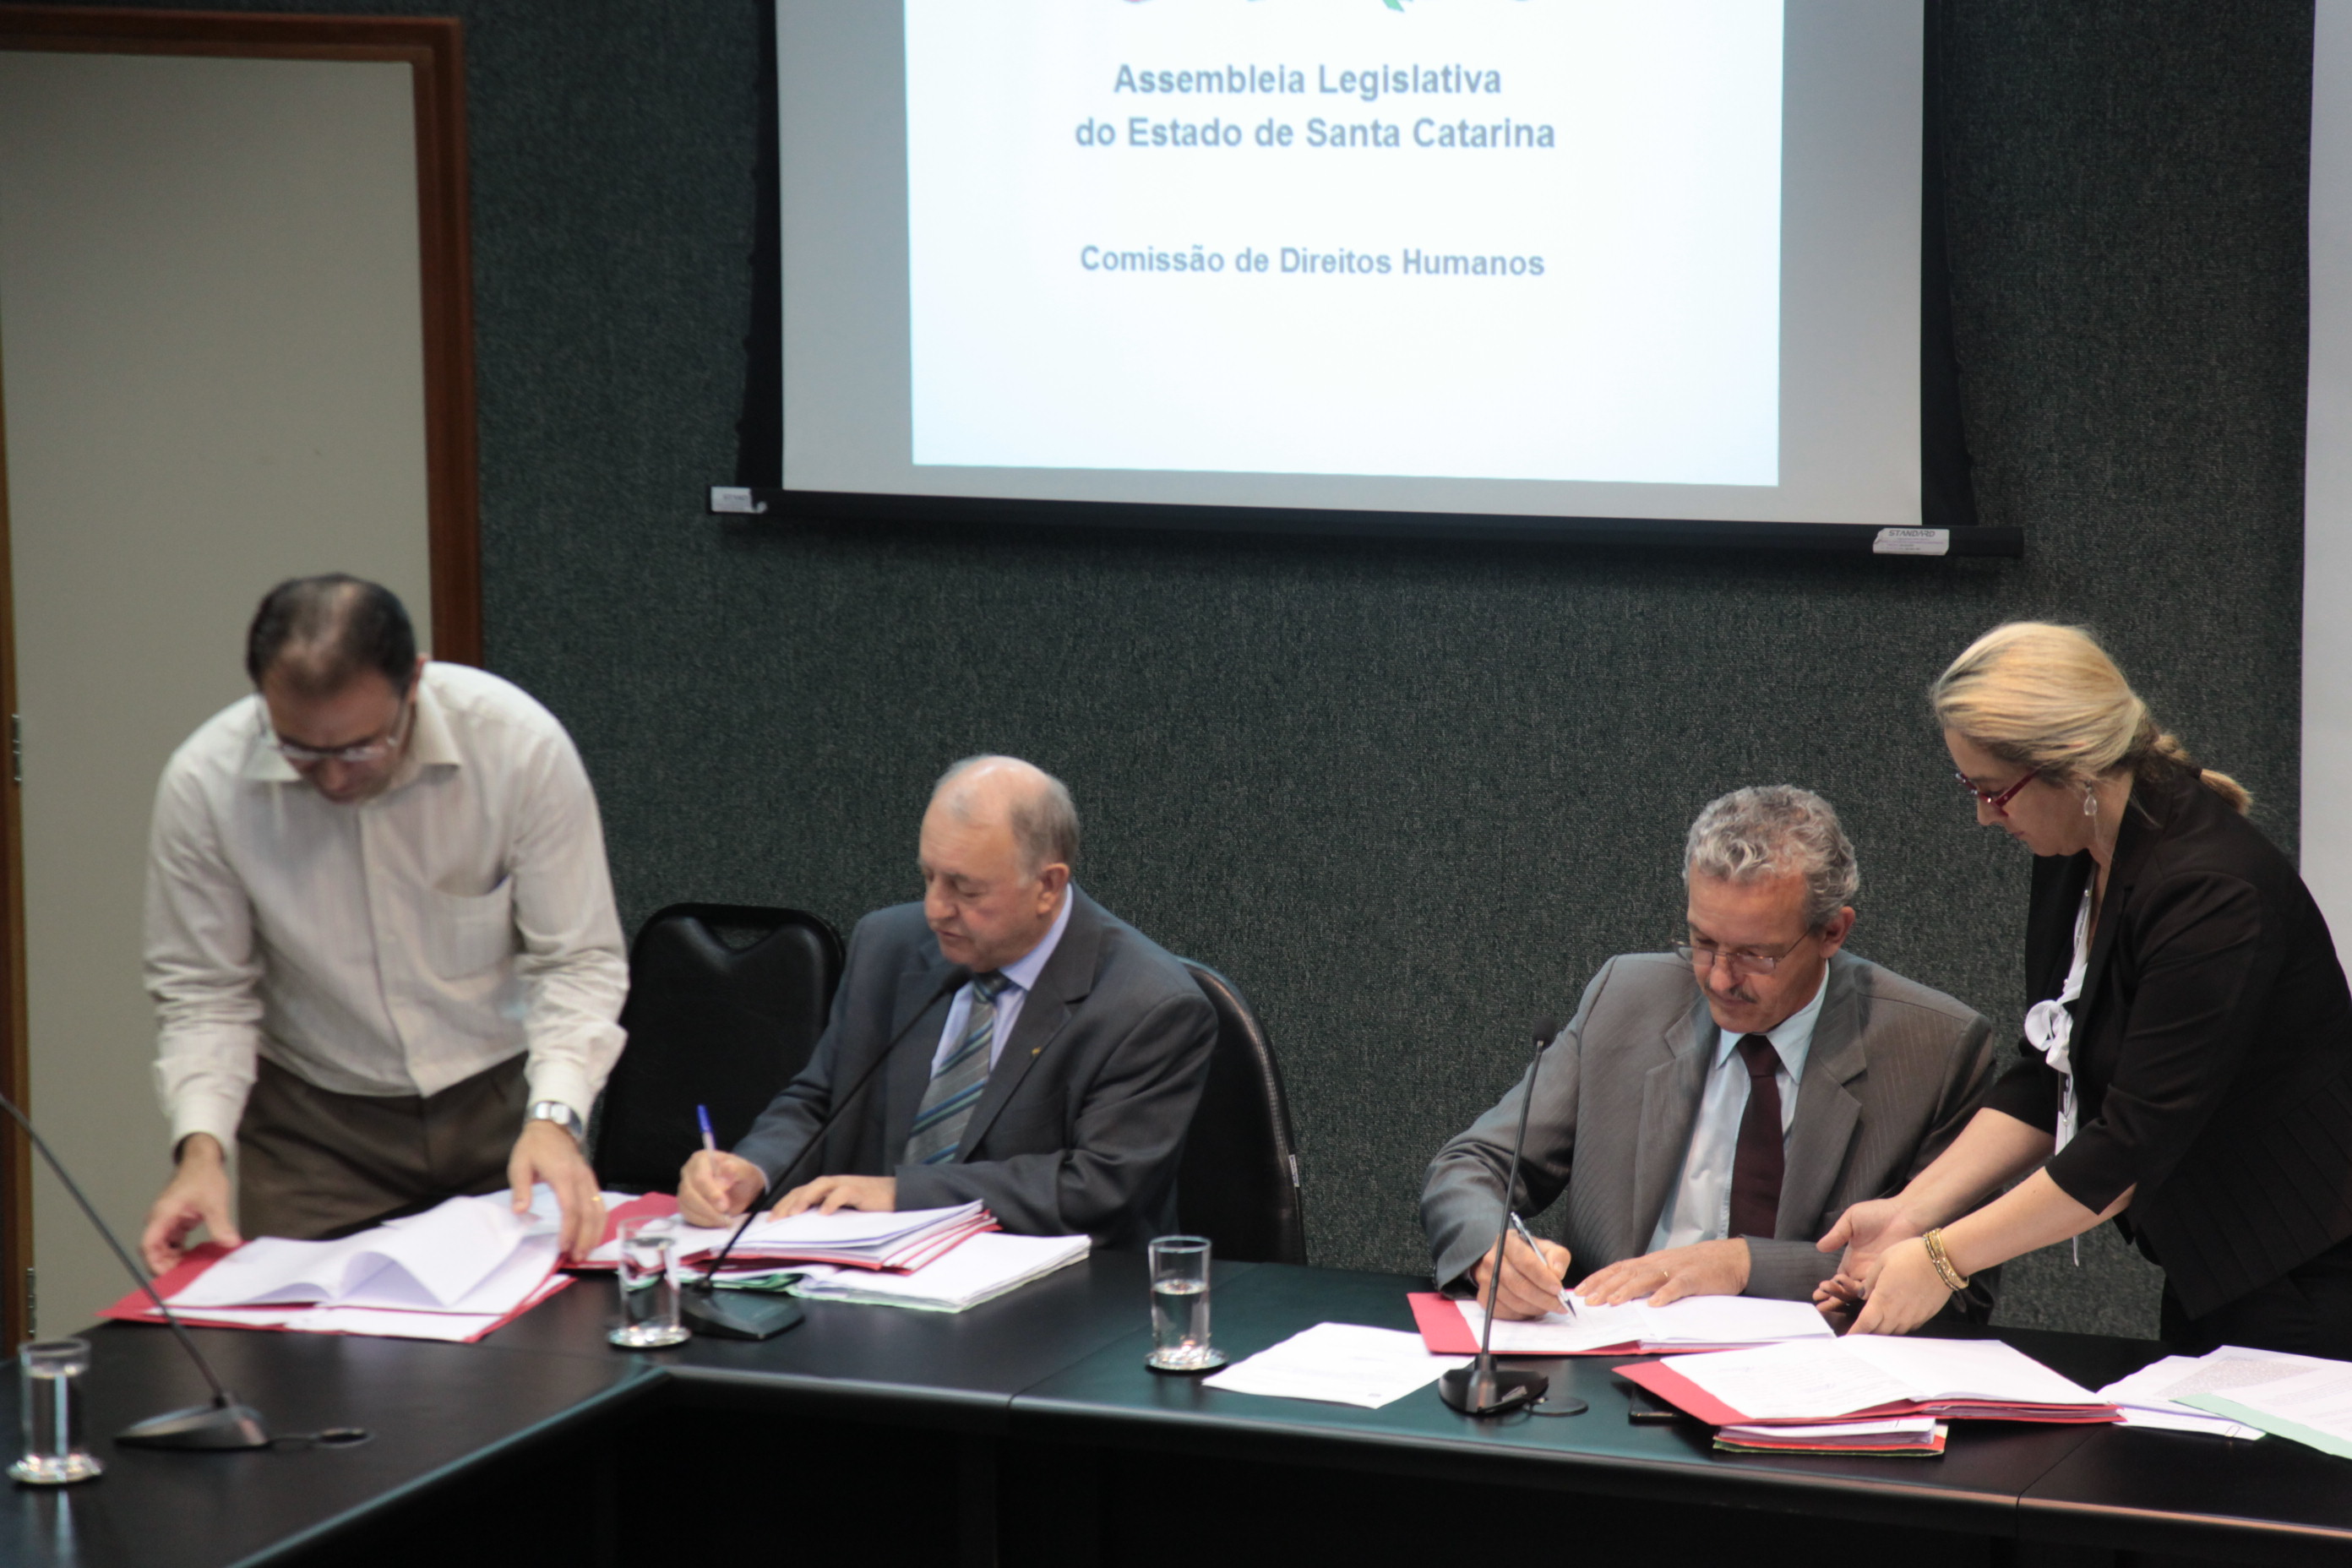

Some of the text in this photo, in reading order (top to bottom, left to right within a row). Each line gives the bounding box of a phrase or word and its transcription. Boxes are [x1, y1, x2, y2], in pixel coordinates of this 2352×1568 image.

[1113, 63, 1501, 101] Assembleia Legislativa
[1075, 117, 1554, 148] do Estado de Santa Catarina
[1081, 244, 1544, 275] Comissão de Direitos Humanos
